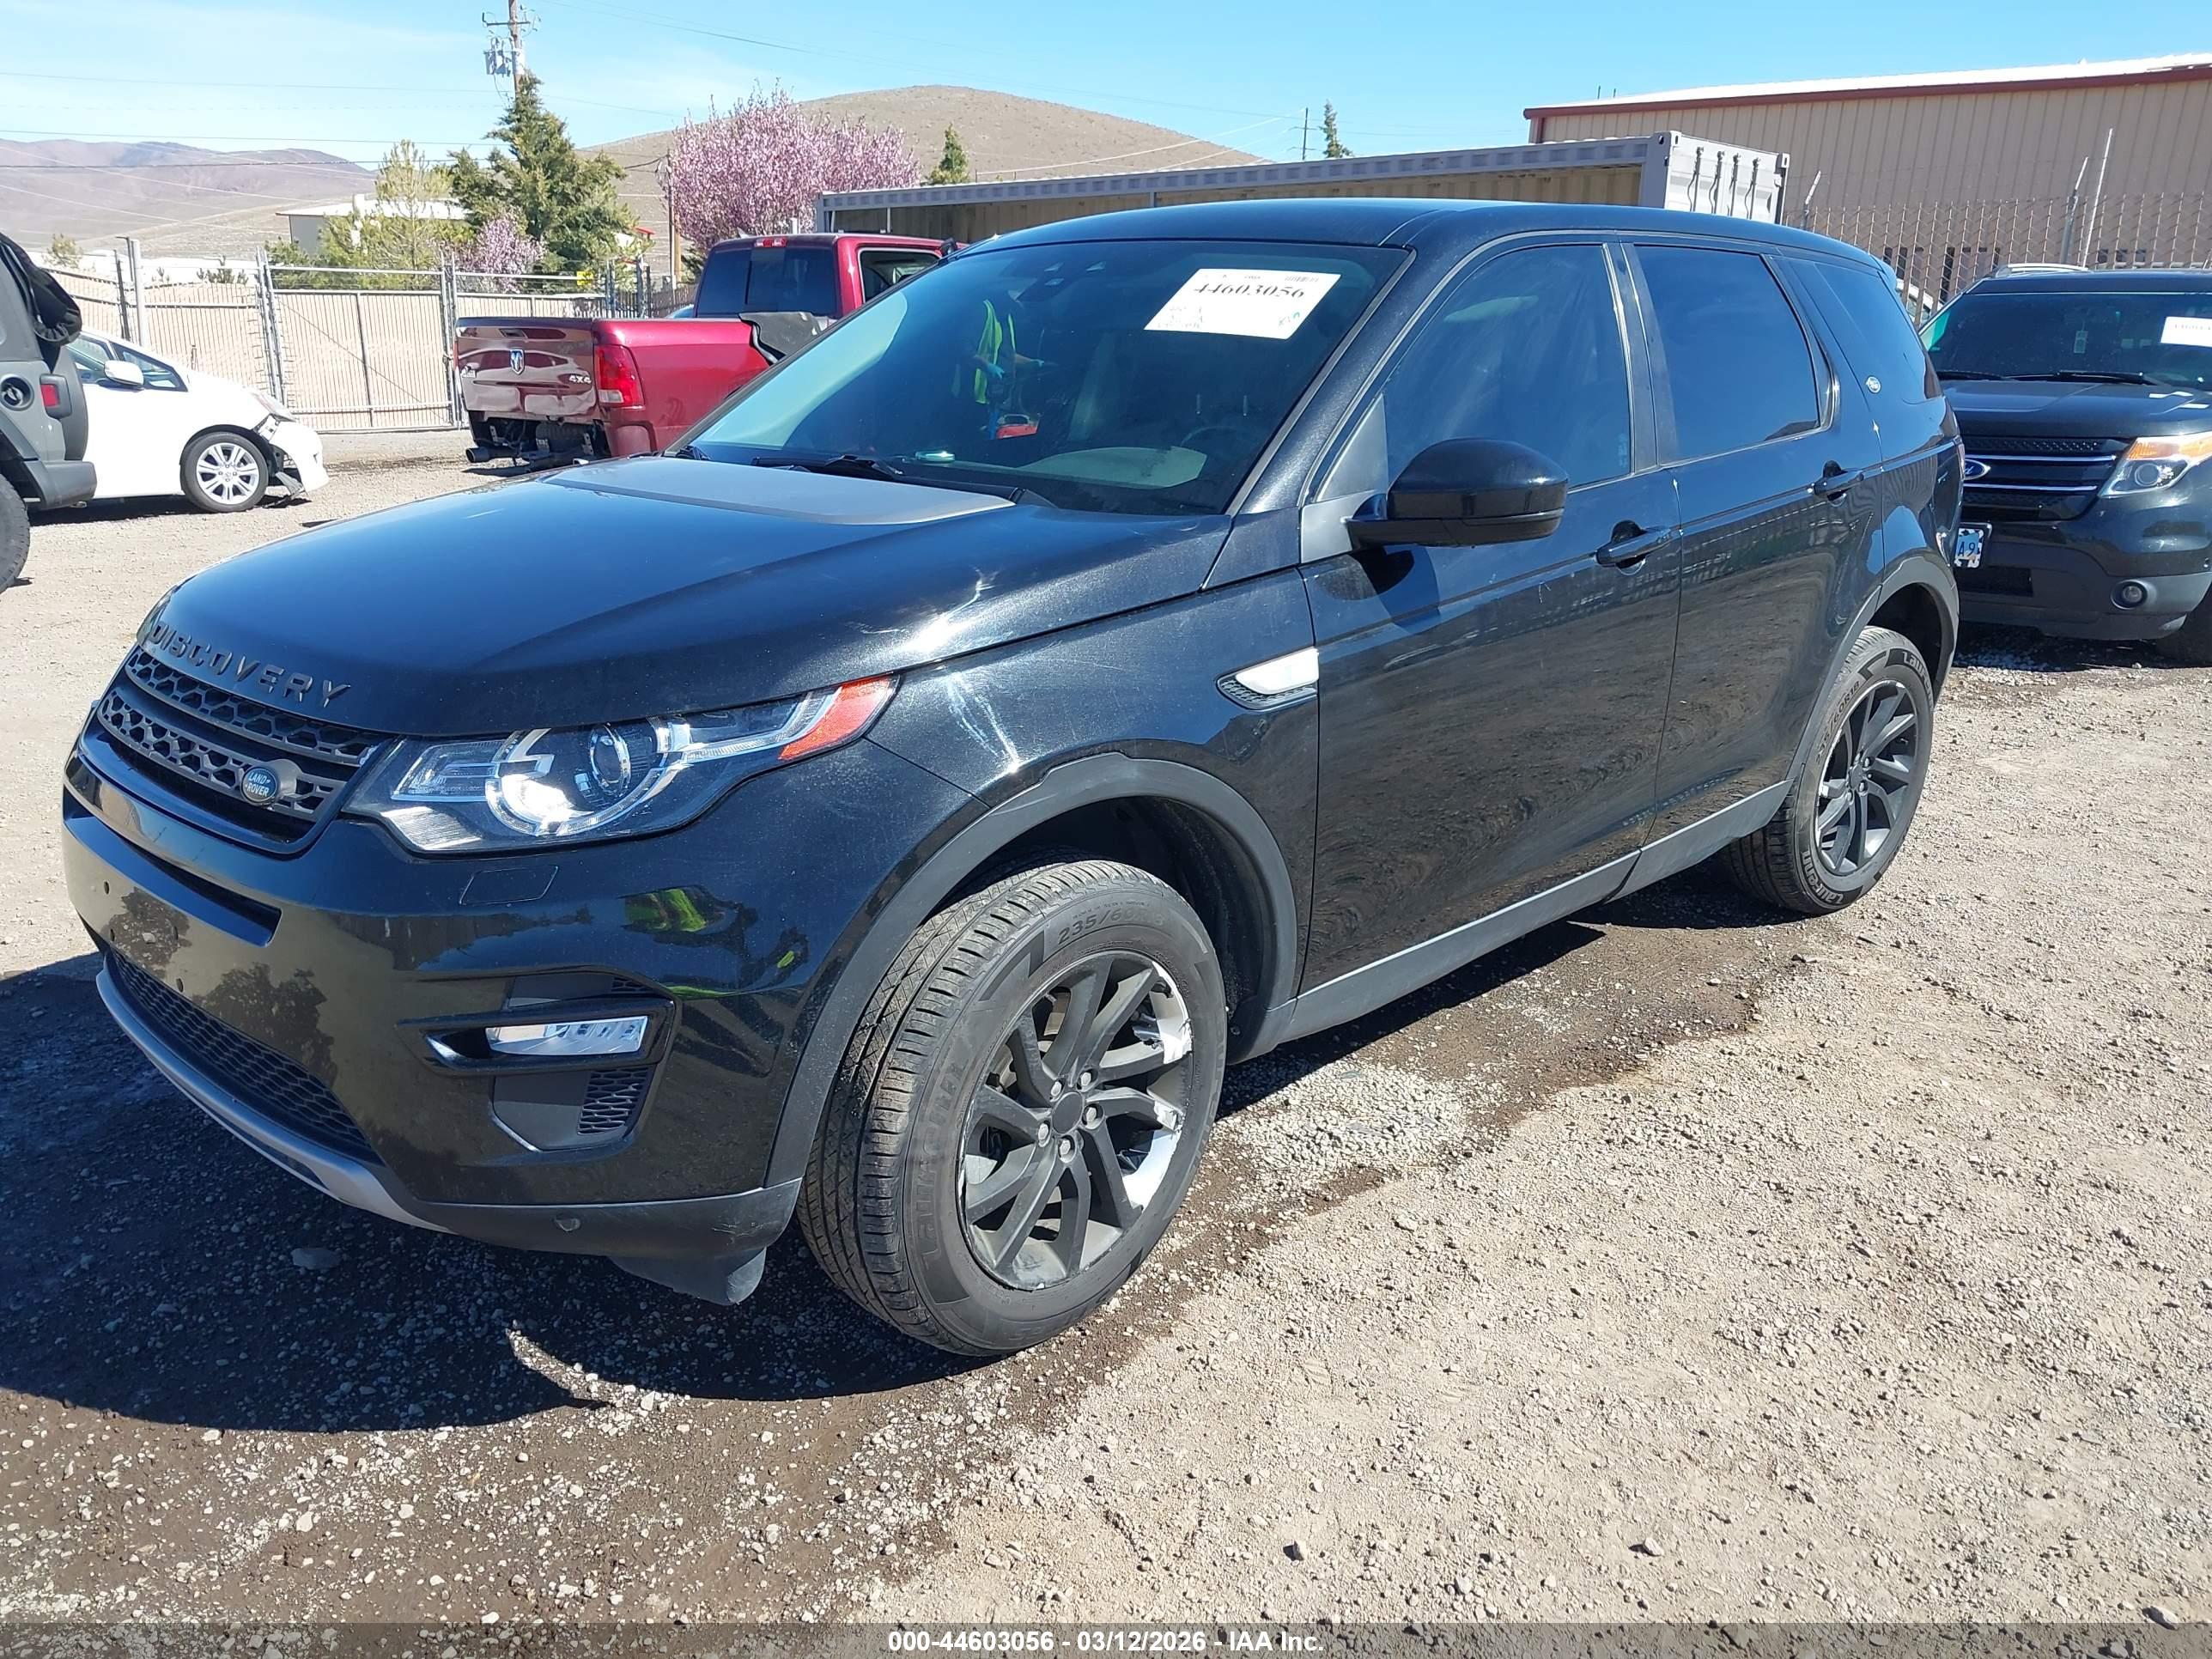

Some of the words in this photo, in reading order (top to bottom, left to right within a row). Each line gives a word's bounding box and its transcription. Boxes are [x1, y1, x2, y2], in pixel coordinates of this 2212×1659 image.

[149, 624, 351, 708] DISCOVERY
[248, 772, 268, 785] LAND
[247, 782, 270, 797] ROVER
